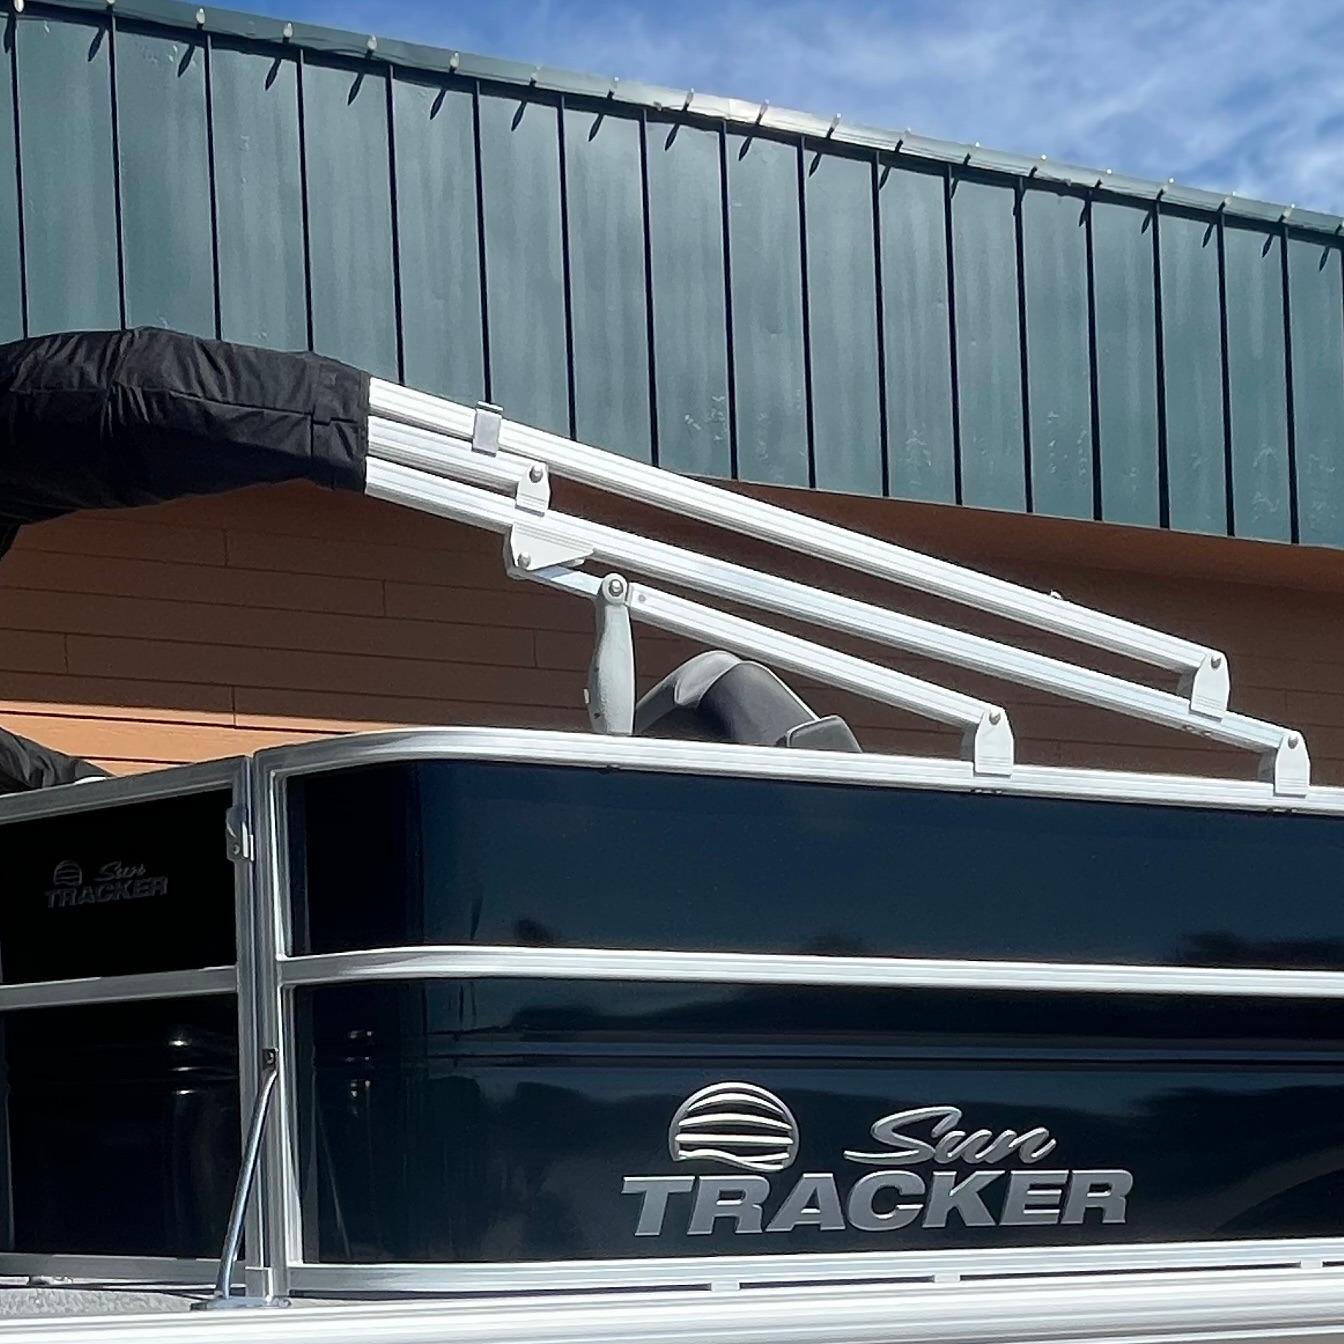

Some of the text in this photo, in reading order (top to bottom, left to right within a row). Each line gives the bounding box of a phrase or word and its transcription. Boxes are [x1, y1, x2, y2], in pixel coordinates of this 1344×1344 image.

[44, 875, 169, 909] TRACKER
[843, 1105, 1057, 1166] Sun
[621, 1168, 1134, 1237] TRACKER
